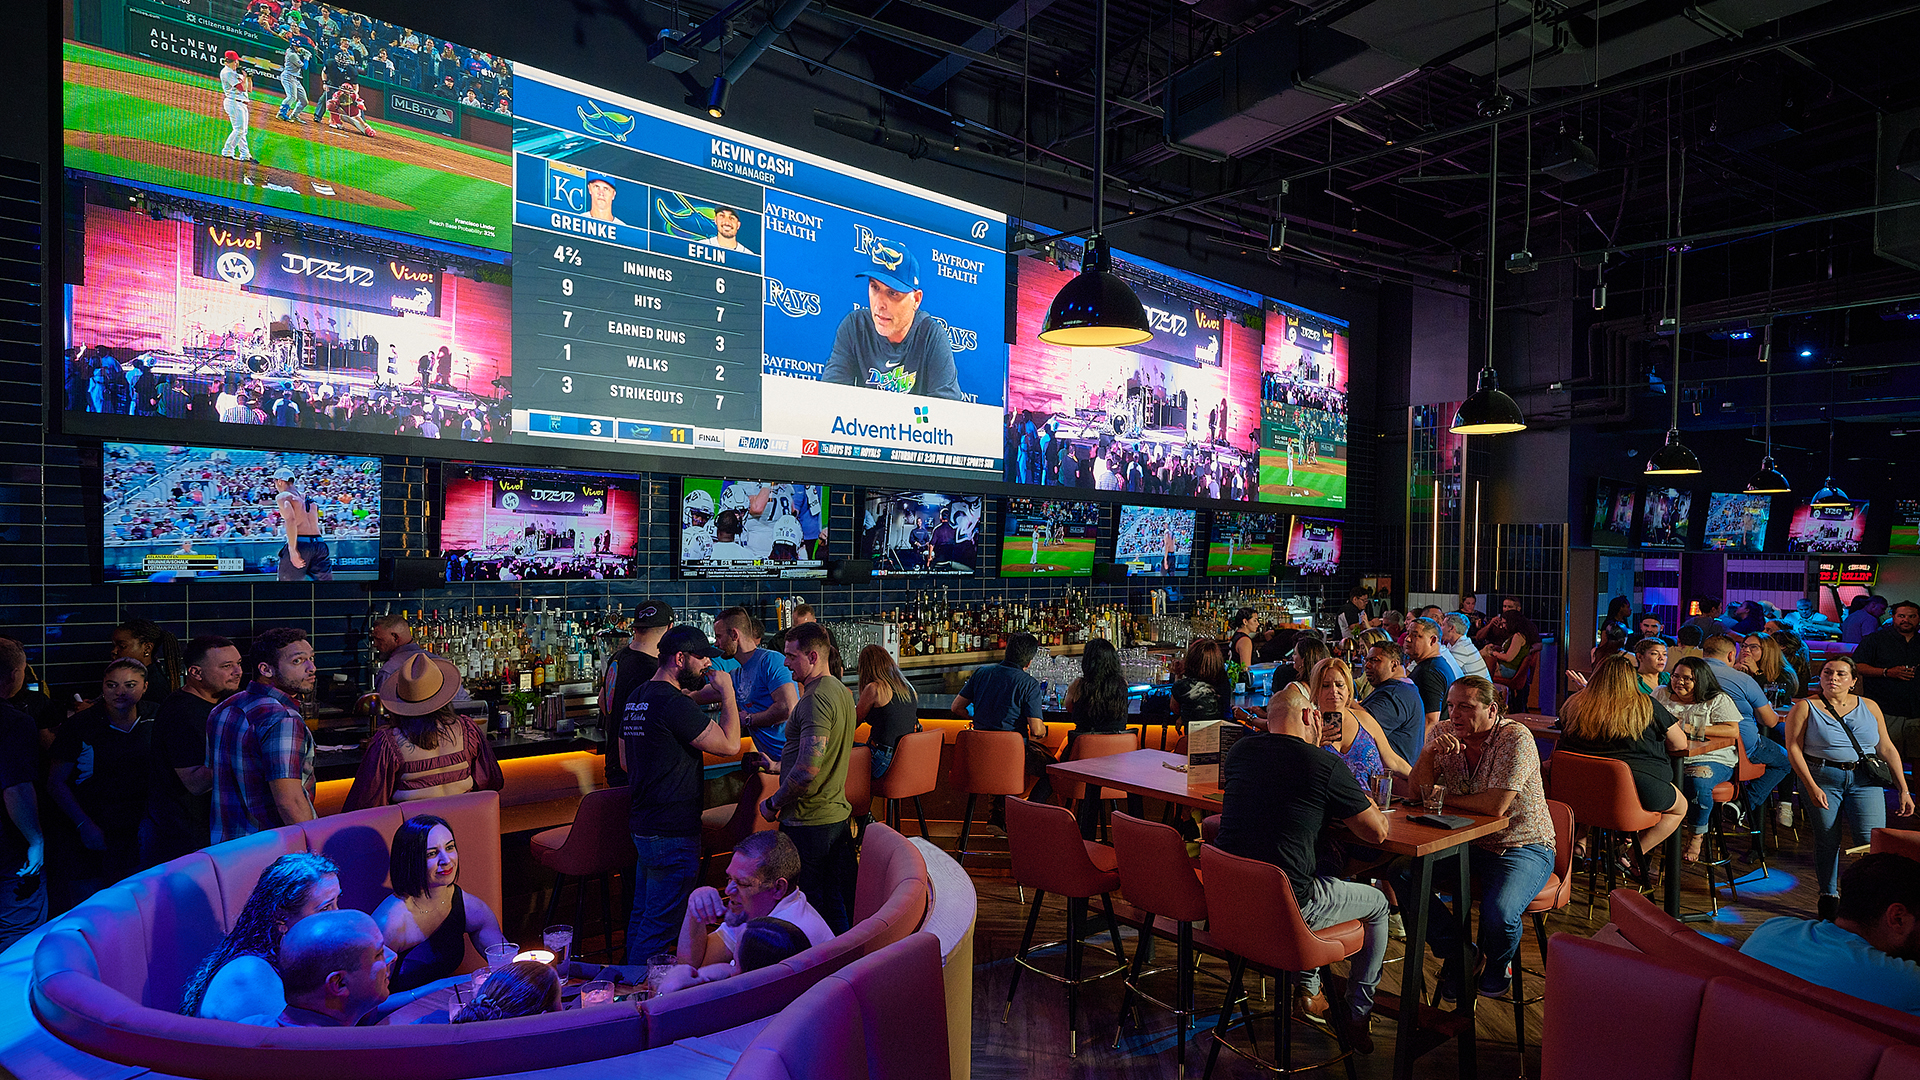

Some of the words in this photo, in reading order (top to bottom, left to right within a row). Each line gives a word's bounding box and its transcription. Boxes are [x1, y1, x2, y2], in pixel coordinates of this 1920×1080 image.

[197, 17, 226, 31] Citizens
[225, 26, 243, 36] Bank
[243, 30, 259, 40] Park
[150, 28, 218, 54] ALL-NEW
[711, 138, 754, 166] KEVIN
[757, 152, 794, 177] CASH
[711, 157, 734, 173] RAYS
[734, 164, 775, 184] MANAGER
[483, 230, 496, 238] 32%
[551, 213, 617, 241] GREINKE
[765, 215, 817, 243] HEALTH
[208, 225, 262, 250] Vivo!
[688, 243, 726, 264] EFLIN
[931, 248, 985, 273] BAYFRONT
[389, 261, 434, 284] Vivo!
[623, 261, 673, 283] INNINGS
[937, 263, 978, 285] HEALTH
[561, 278, 574, 297] 9
[715, 277, 726, 294] 6
[634, 293, 662, 311] HITS
[562, 310, 573, 329] 7
[715, 306, 725, 323] 7
[1194, 308, 1220, 331] Vivo!
[608, 320, 655, 340] EARNED
[655, 328, 687, 345] RUNS
[563, 343, 572, 362] 1
[715, 335, 726, 352] 3
[626, 354, 669, 373] WALKS
[715, 364, 725, 382] 2
[561, 375, 573, 395] 3
[609, 384, 684, 405] STRIKEOUTS
[715, 394, 725, 411] 7
[589, 420, 602, 436] 3
[670, 428, 685, 443] 11
[698, 433, 721, 444] FINAL
[748, 437, 769, 450] RAYS
[770, 440, 788, 451] LIVE
[828, 444, 844, 456] RAYS
[843, 447, 852, 456] VS
[860, 447, 881, 460] ROYALS
[890, 449, 917, 462] SATURDAY
[916, 453, 924, 463] AT
[499, 479, 524, 492] Vivo!
[582, 485, 604, 497] Vivo!
[340, 557, 376, 566] BAKERY
